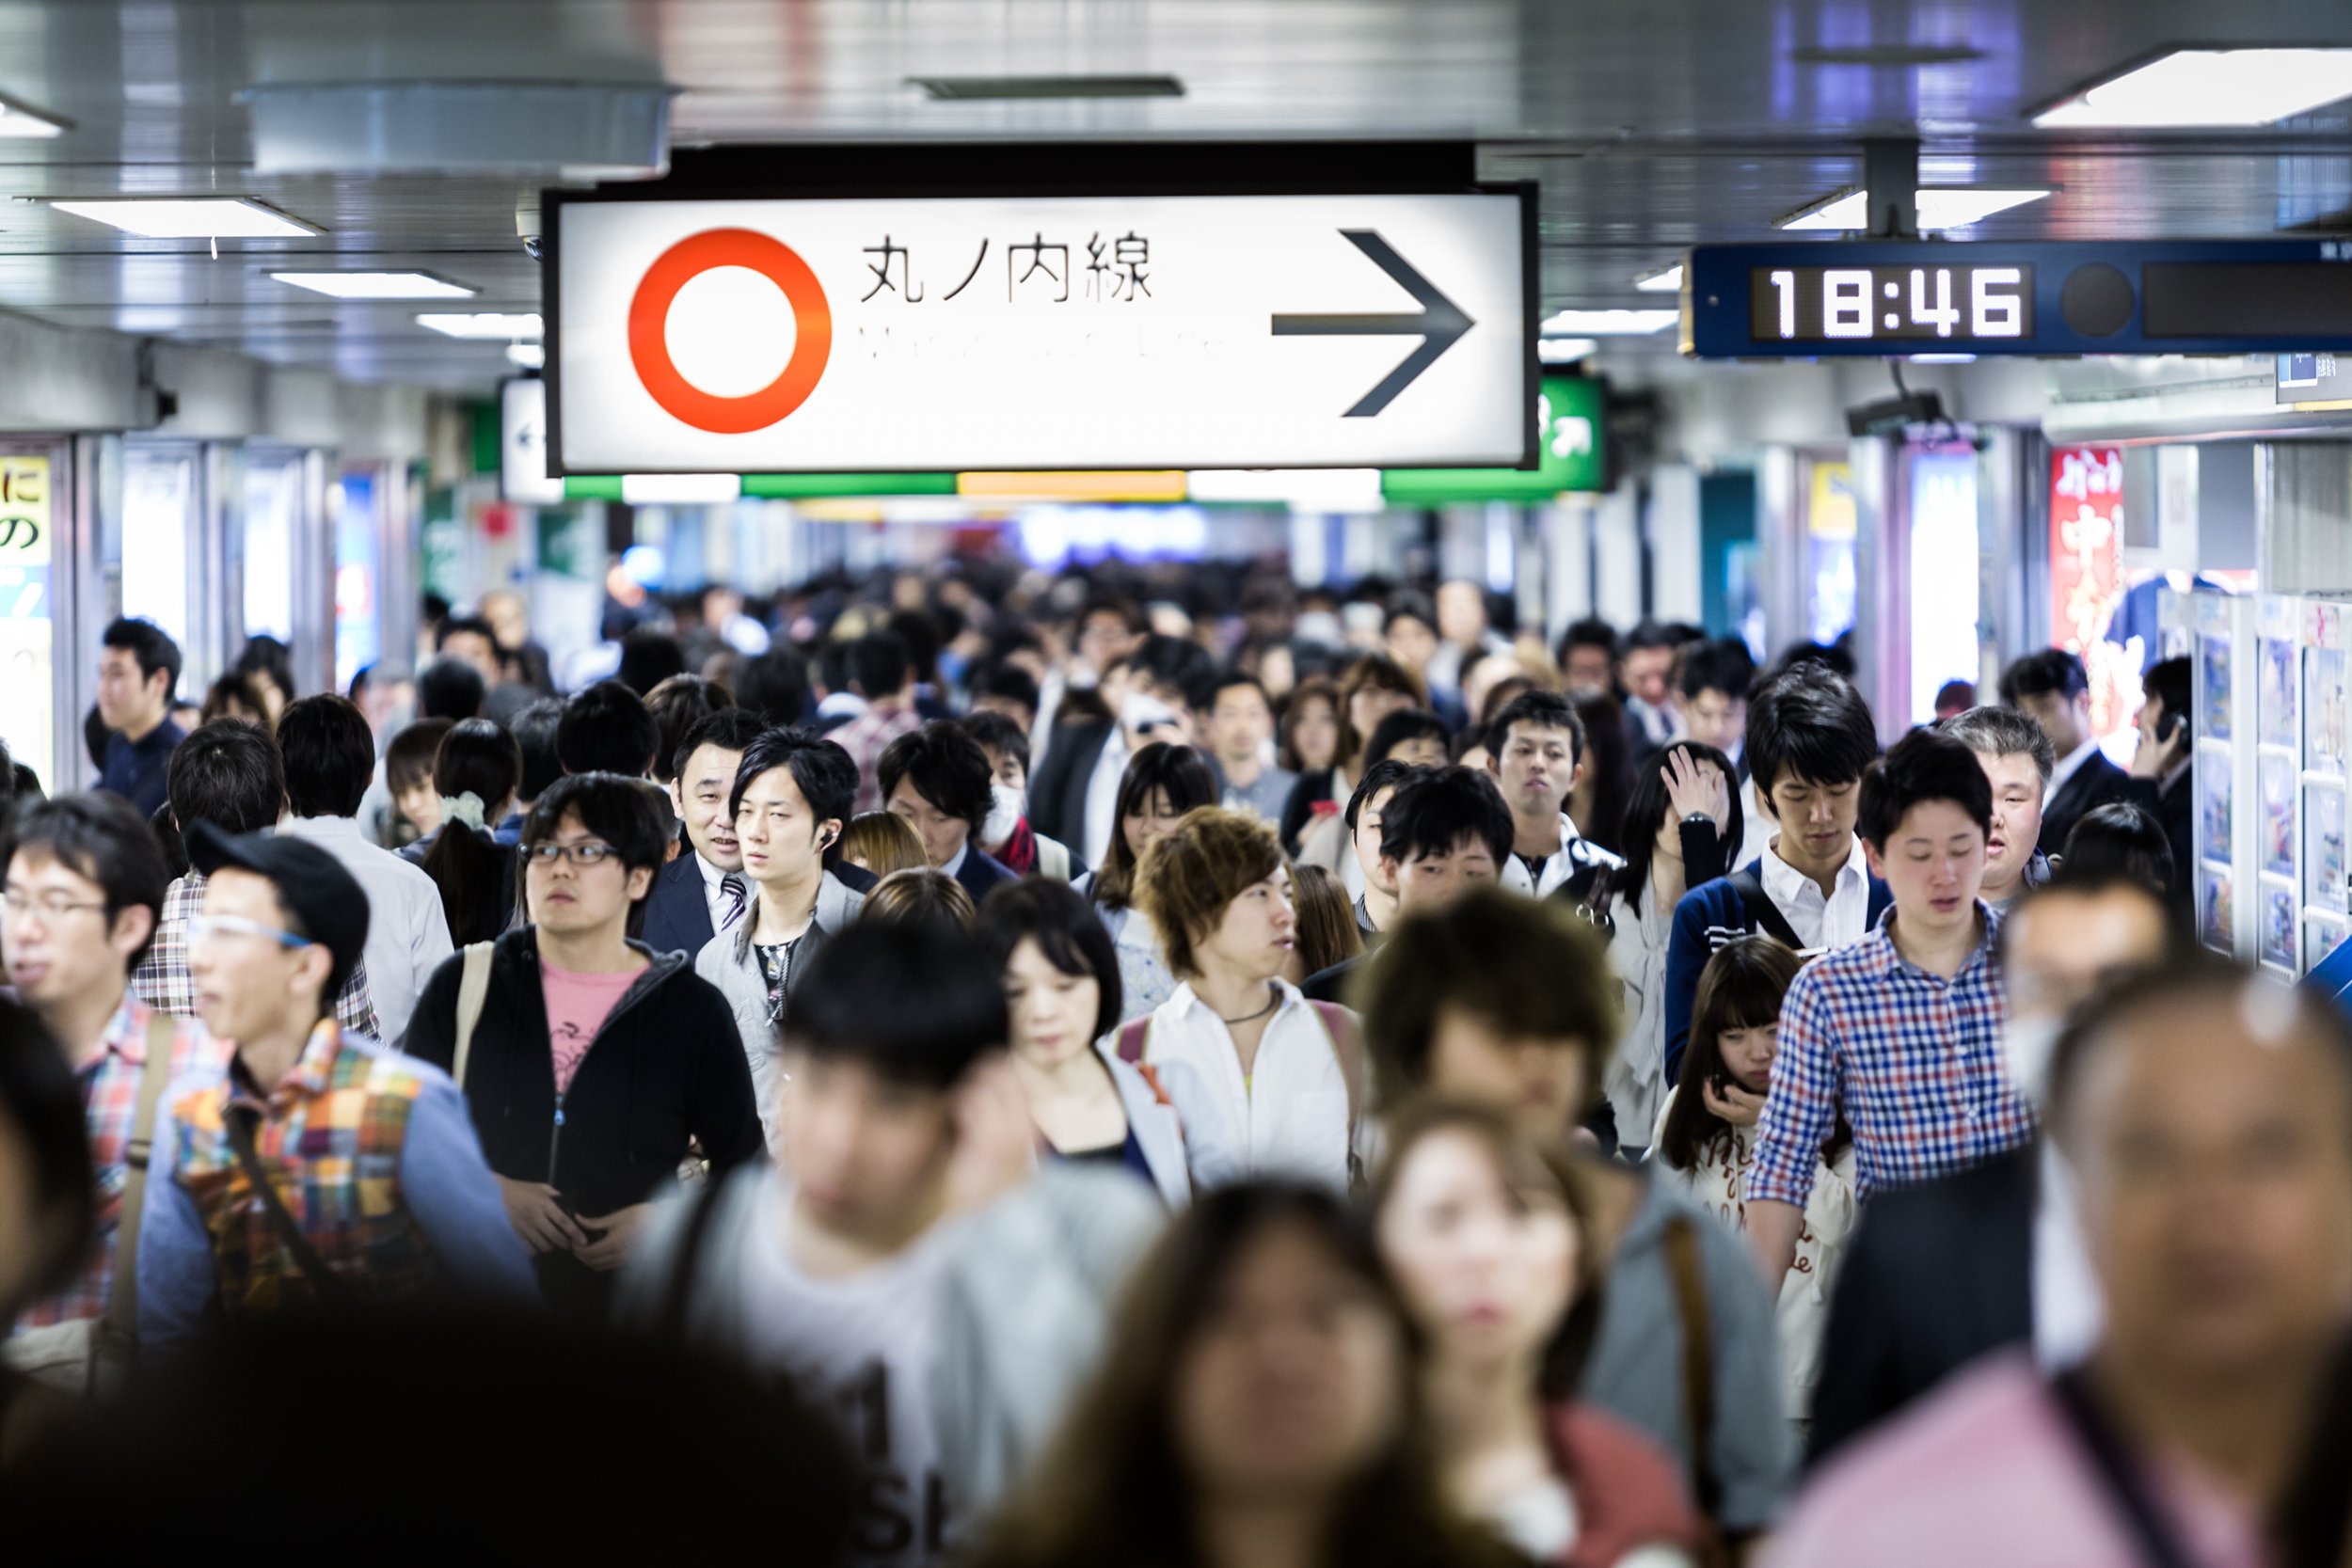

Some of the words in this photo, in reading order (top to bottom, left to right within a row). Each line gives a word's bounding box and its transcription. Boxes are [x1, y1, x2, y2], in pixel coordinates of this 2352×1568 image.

[860, 230, 1152, 303] 丸ノ内線
[1771, 268, 2021, 338] 18:46
